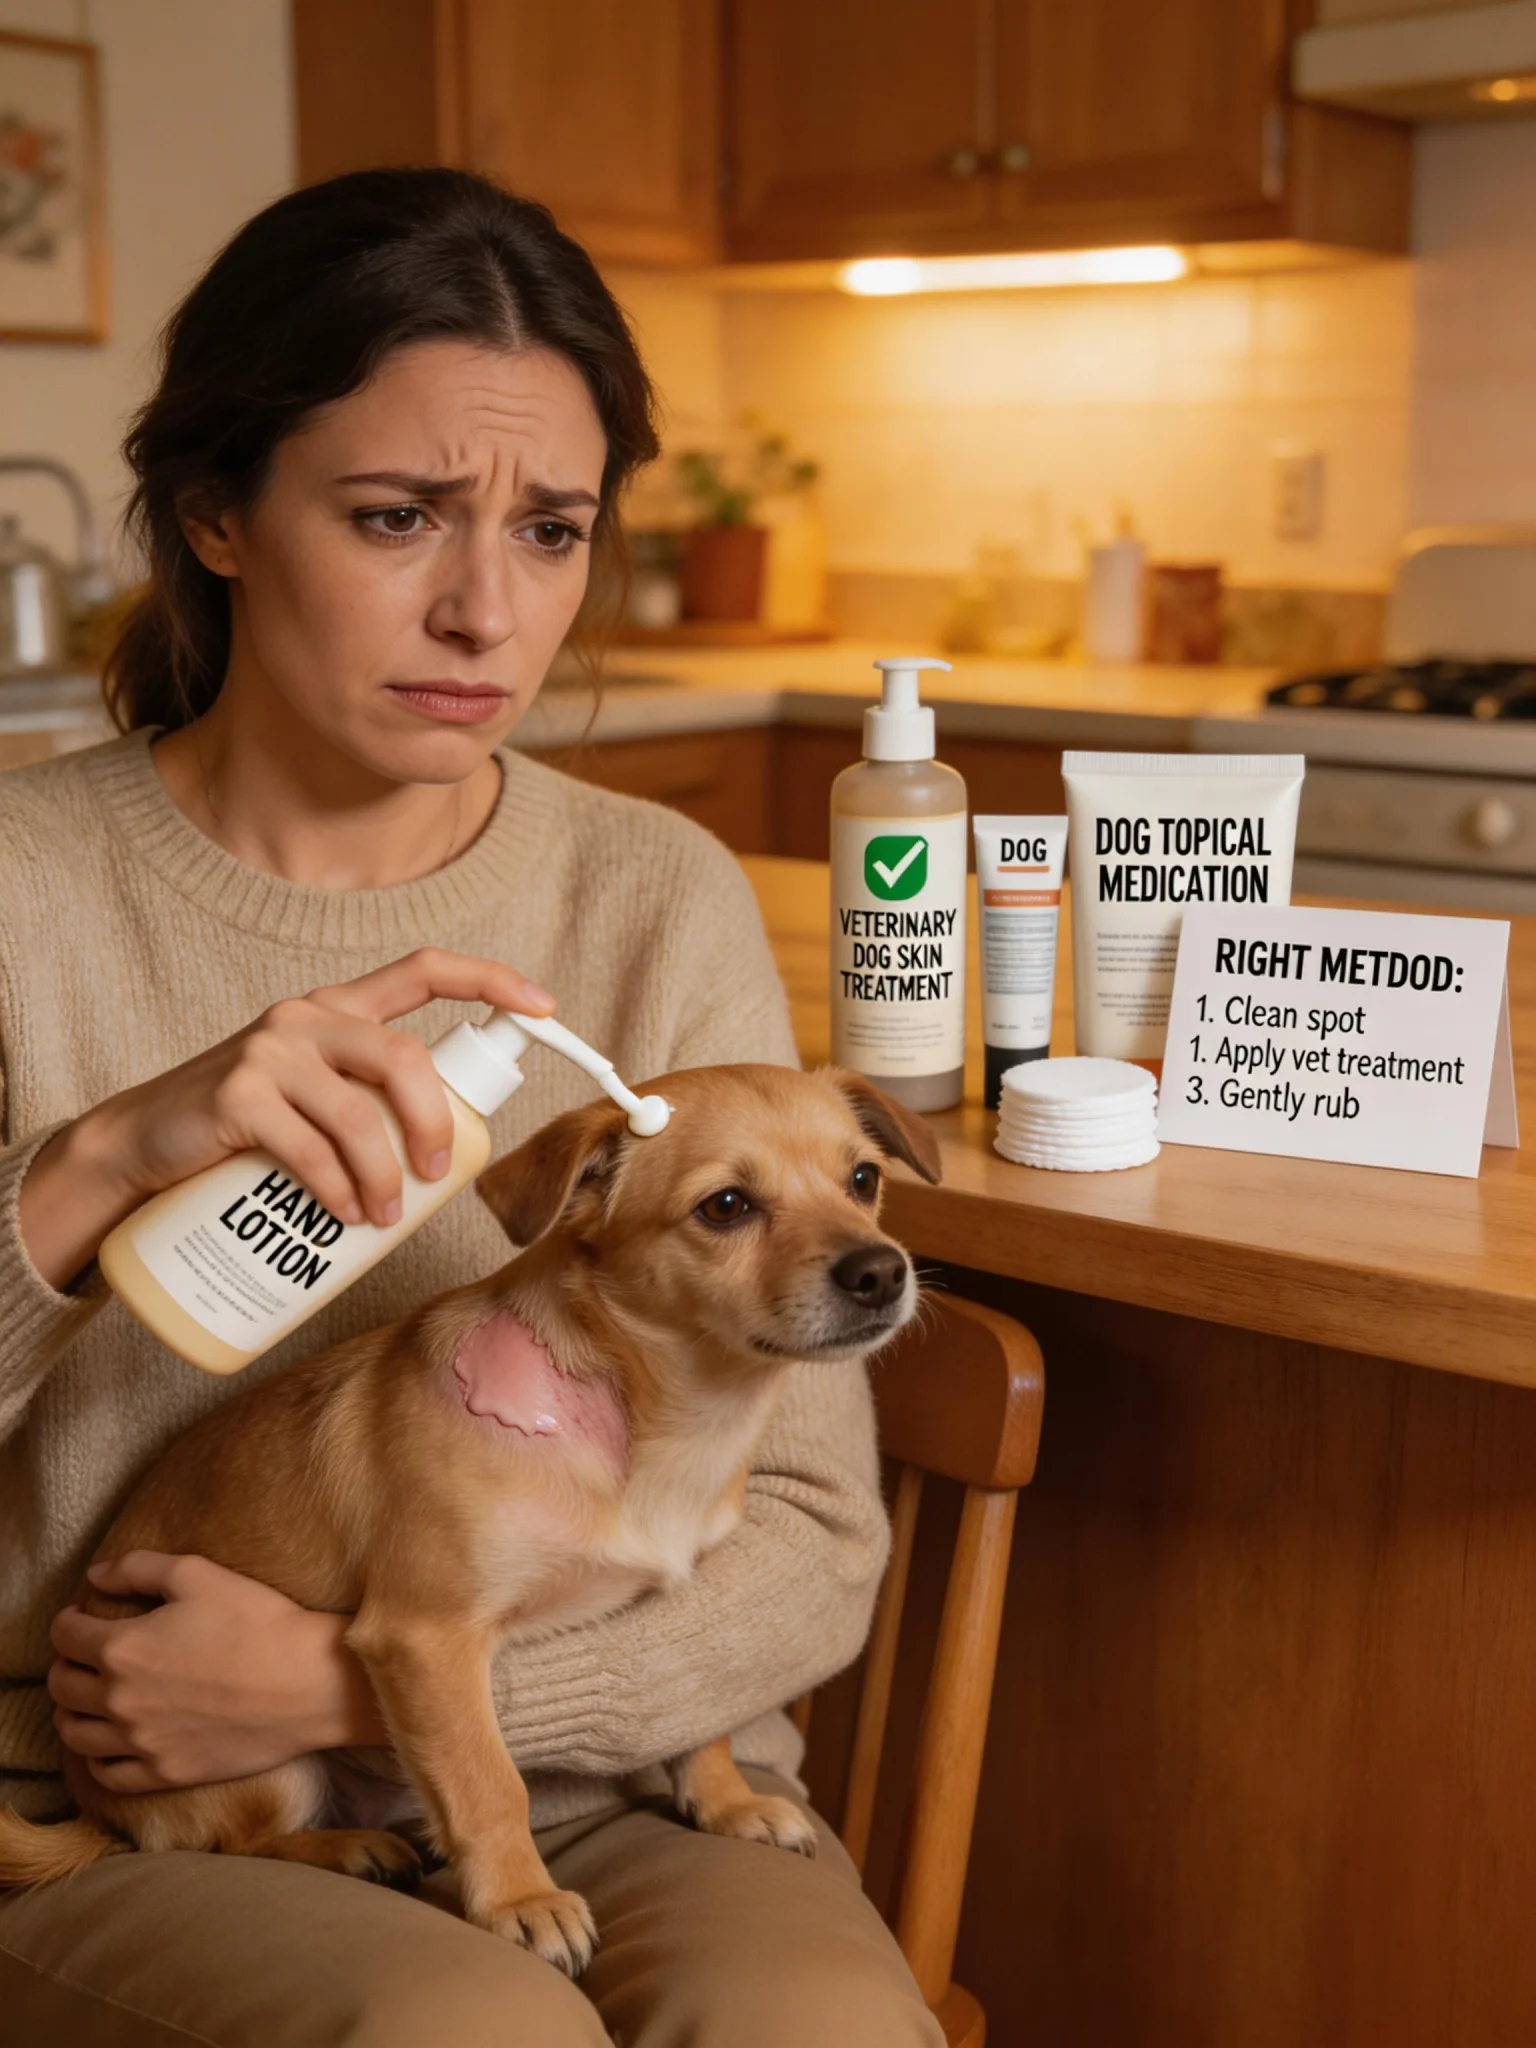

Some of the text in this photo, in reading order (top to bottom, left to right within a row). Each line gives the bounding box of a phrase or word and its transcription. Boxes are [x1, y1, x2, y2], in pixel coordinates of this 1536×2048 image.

[1000, 838, 1047, 863] DOG
[1096, 818, 1271, 857] DOG TOPICAL
[1098, 864, 1269, 903] MEDICATION
[839, 908, 957, 938] VETERINARY
[853, 943, 943, 970] DOG SKIN
[1215, 938, 1312, 980] RIGHT
[1320, 946, 1464, 993] METDOD:
[841, 971, 953, 1002] TREATMENT
[1196, 994, 1214, 1023] 1.
[1225, 995, 1297, 1029] Clean
[1307, 1006, 1366, 1040] spot
[1189, 1035, 1465, 1085] 1. Apply vet treatment
[1186, 1076, 1360, 1121] 3. Gently rub
[252, 1170, 344, 1249] HAND
[219, 1196, 332, 1290] LOTION
